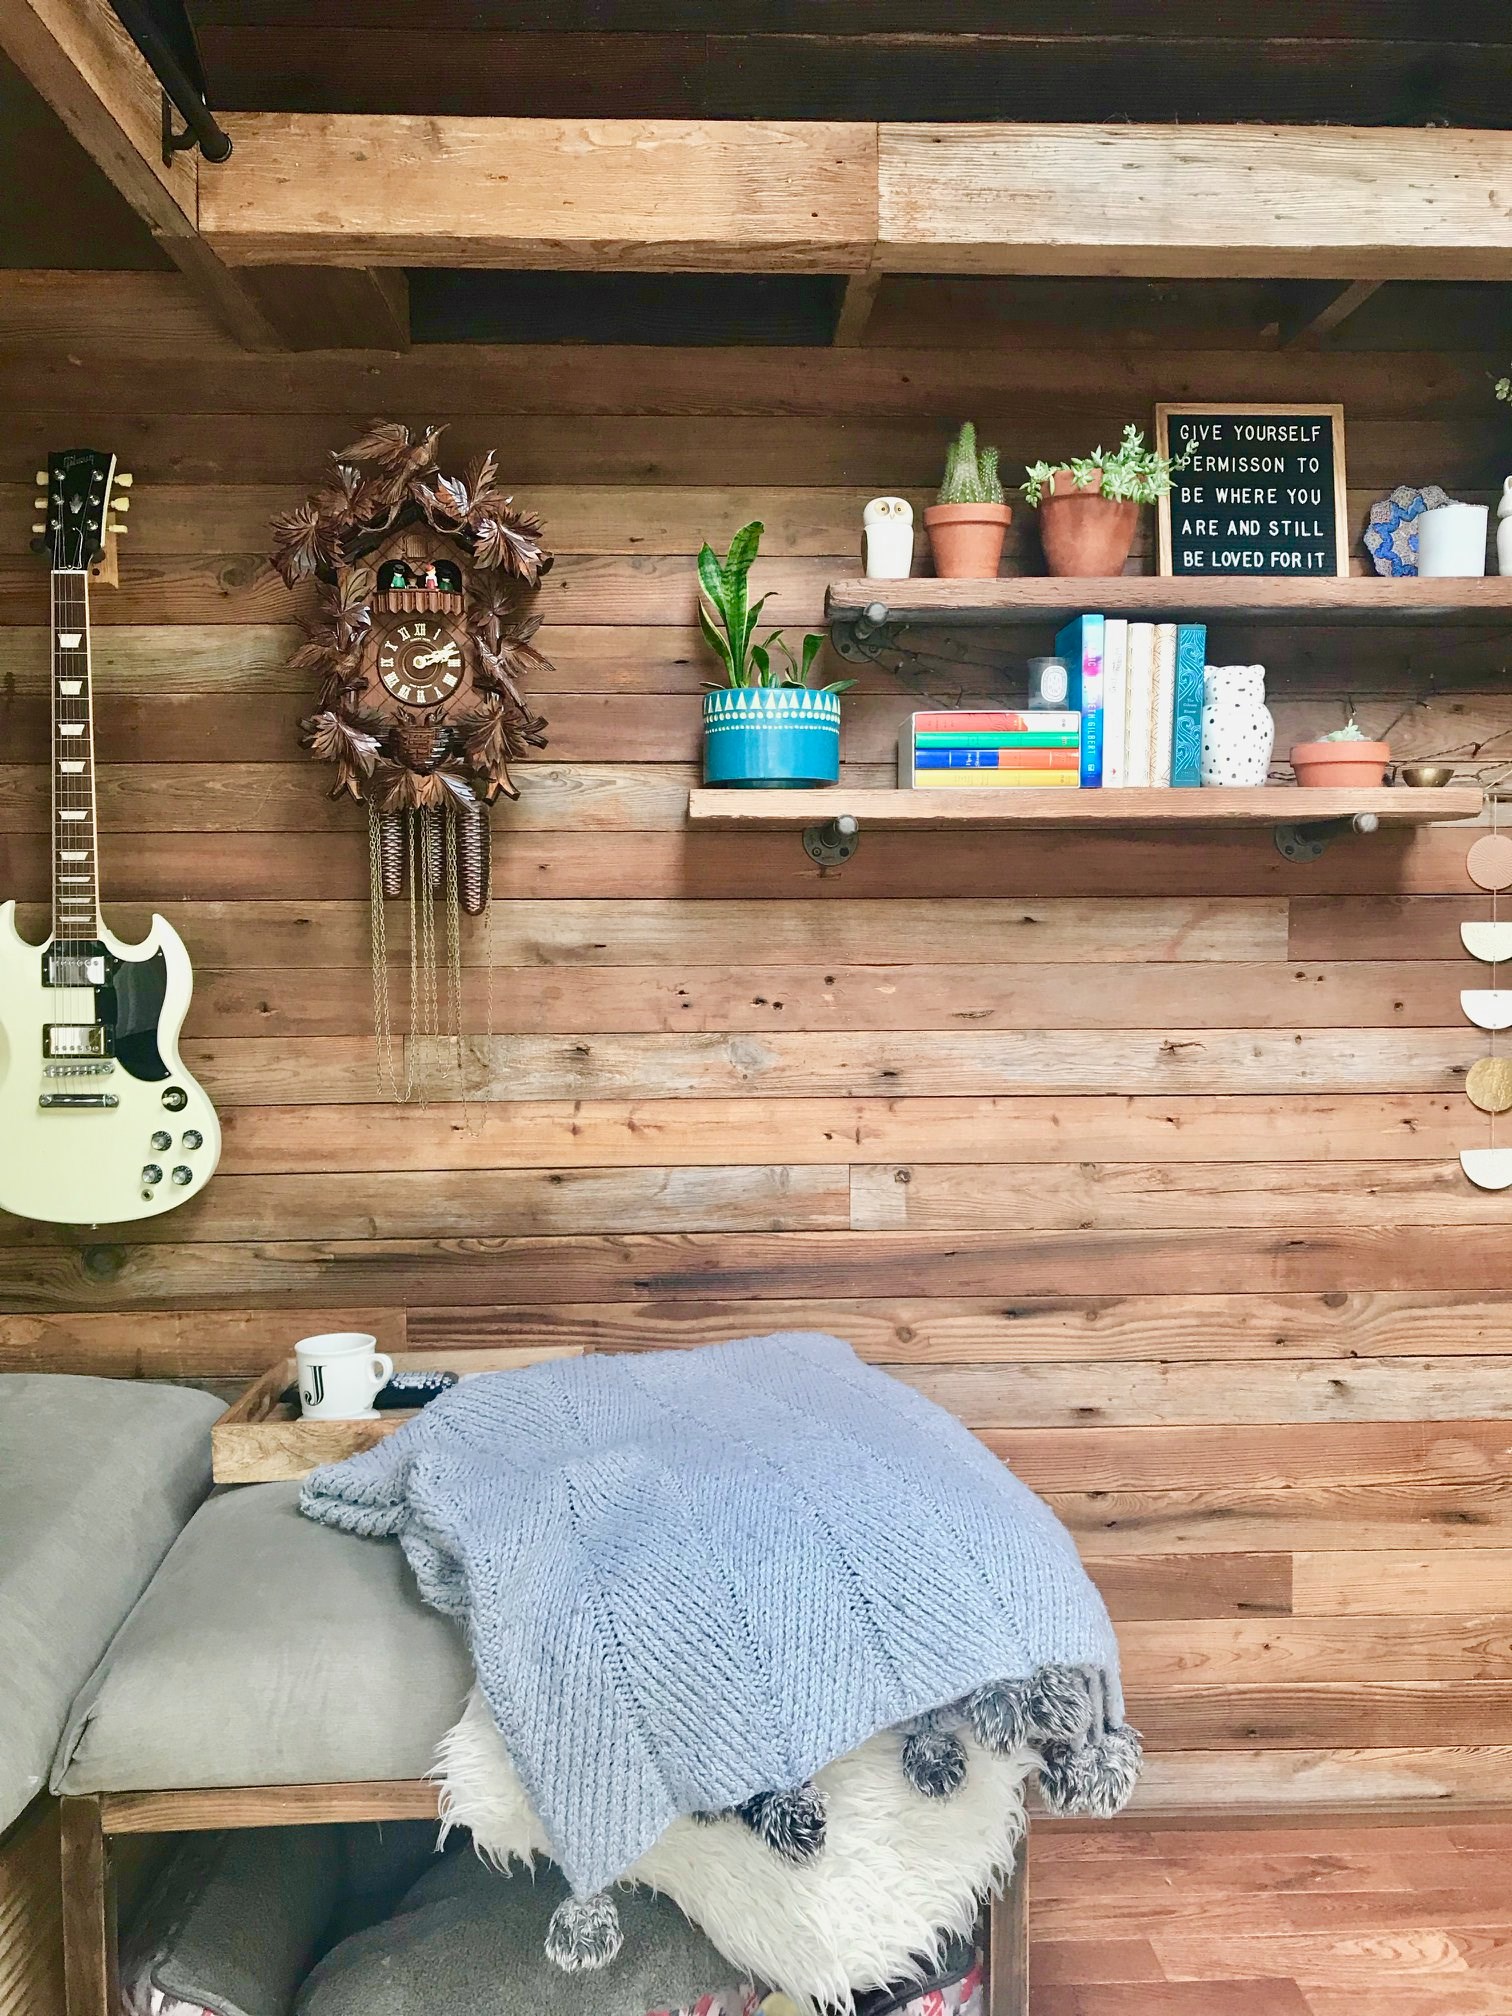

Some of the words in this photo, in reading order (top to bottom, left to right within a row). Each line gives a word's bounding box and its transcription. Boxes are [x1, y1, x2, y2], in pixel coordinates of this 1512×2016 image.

[1180, 424, 1222, 441] GIVE
[1234, 425, 1321, 442] YOURSELF
[1182, 456, 1285, 473] PERMISSON
[1297, 457, 1320, 473] TO
[1181, 487, 1204, 503] BE
[1216, 488, 1277, 504] WHERE
[1287, 489, 1321, 505] YOU
[1181, 519, 1219, 536] ARE
[1227, 520, 1260, 536] AND
[1268, 520, 1324, 537] STILL
[1183, 551, 1204, 567] BE
[1212, 551, 1264, 568] LOVED
[1270, 552, 1302, 568] FOR
[1307, 552, 1325, 569] IT
[1087, 722, 1096, 754] GILBERT
[304, 1364, 328, 1407] J
